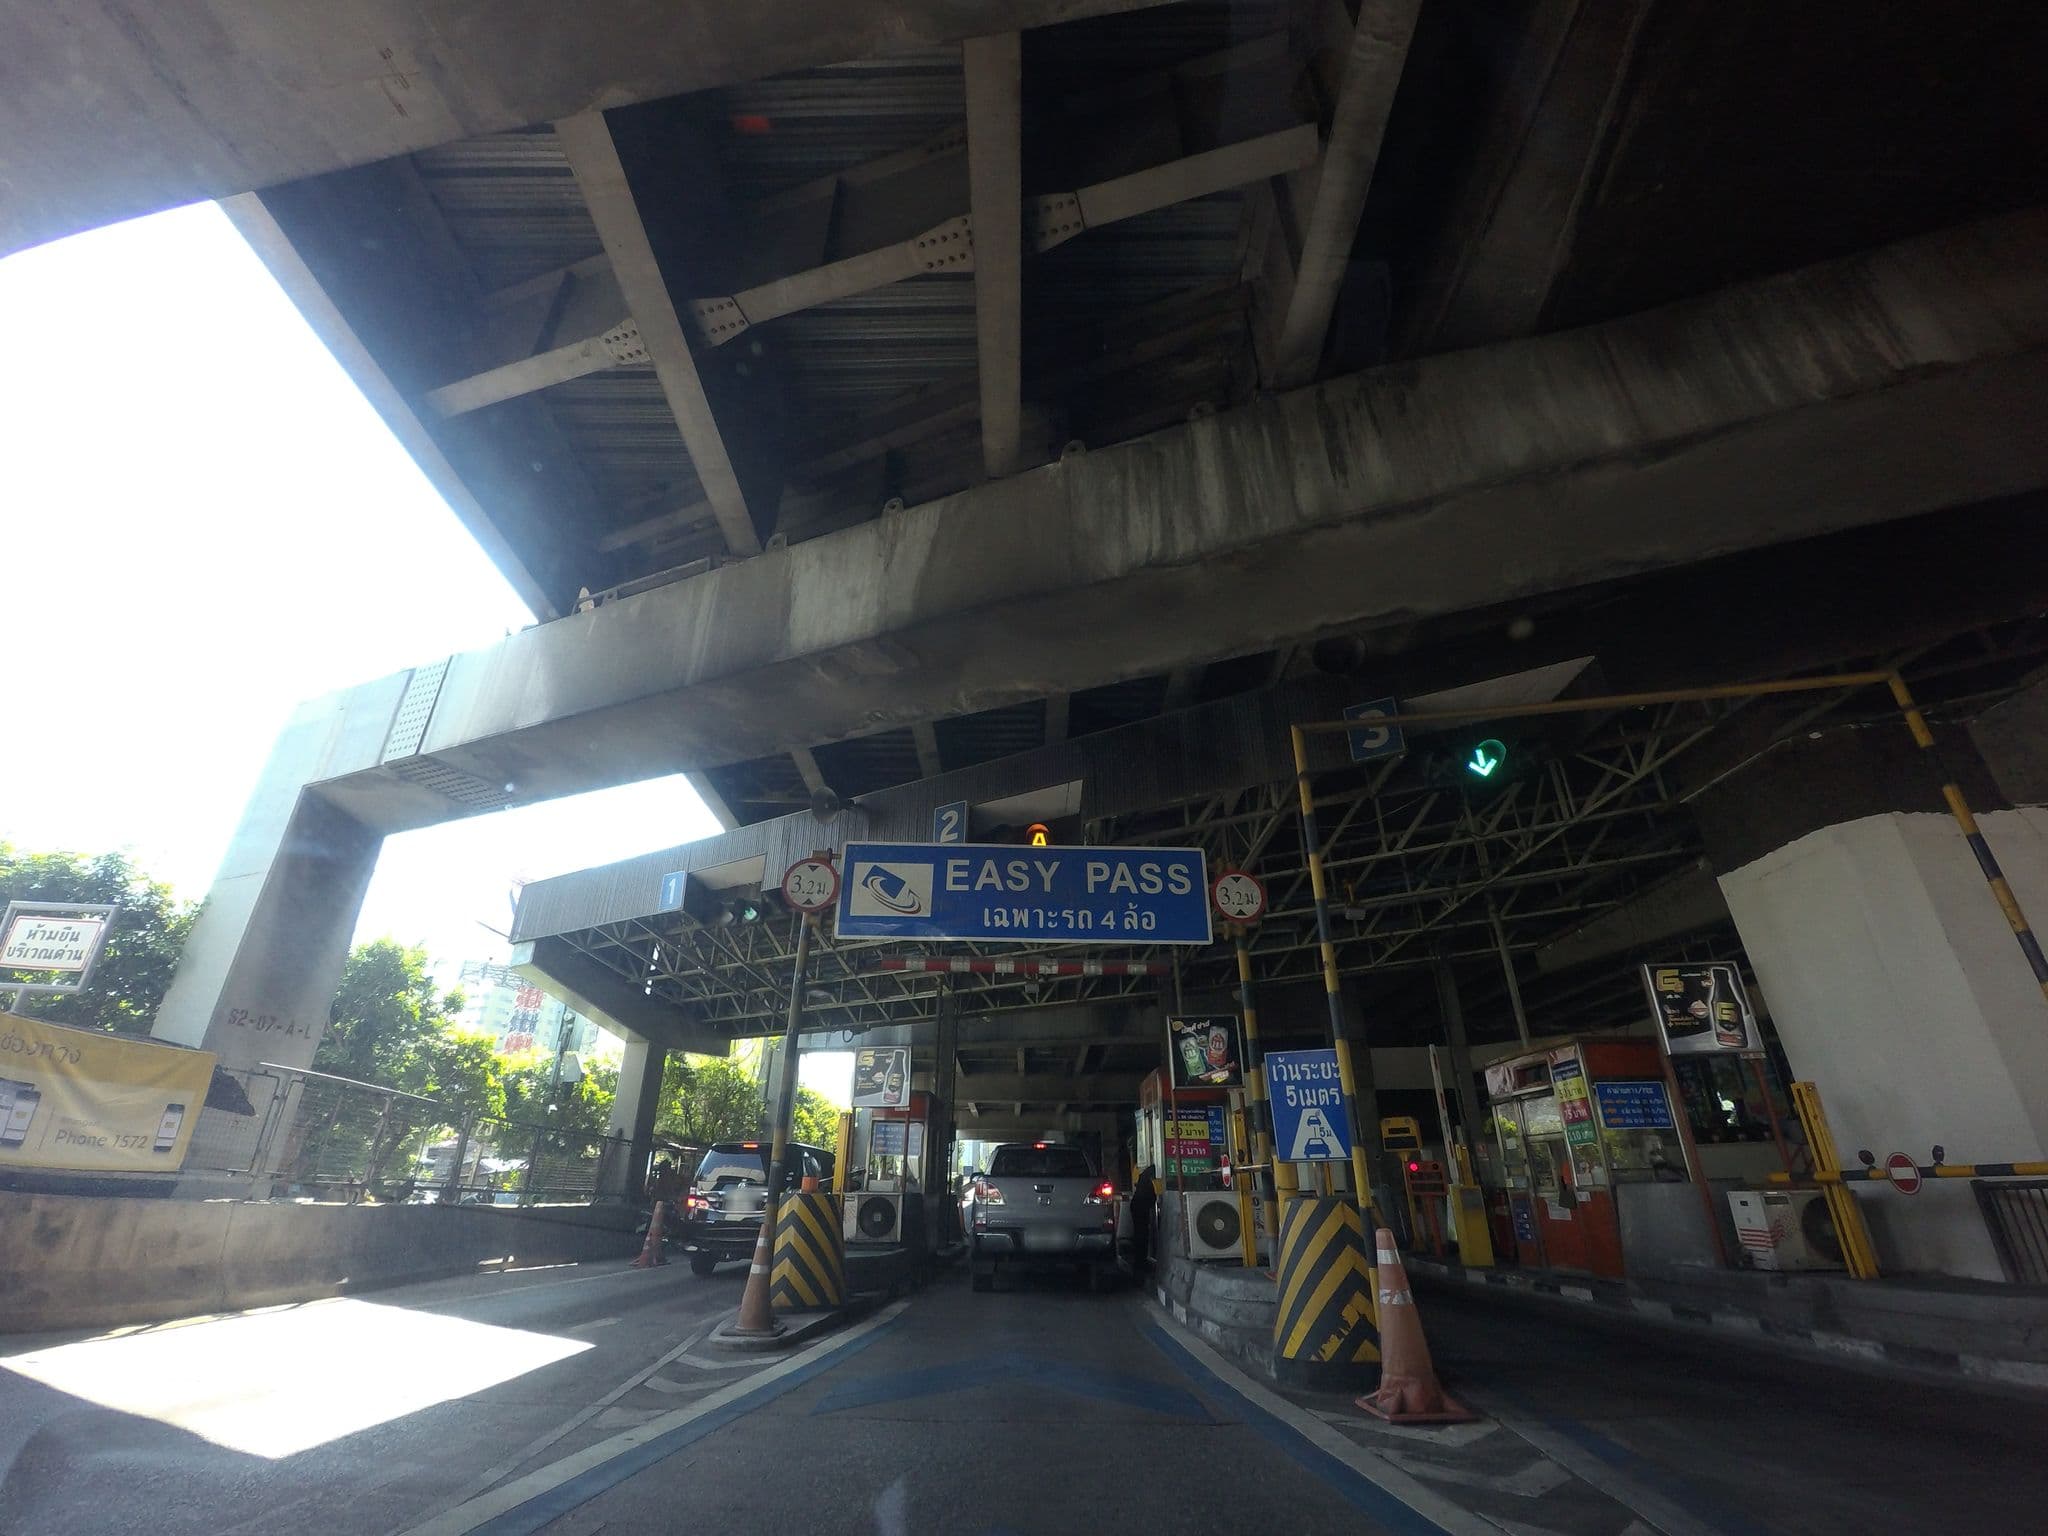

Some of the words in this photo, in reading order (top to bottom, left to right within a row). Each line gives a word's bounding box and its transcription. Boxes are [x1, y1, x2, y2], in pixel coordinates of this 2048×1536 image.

[1358, 708, 1391, 750] 3
[939, 809, 959, 844] 2
[945, 858, 1061, 893] EASY
[1086, 861, 1193, 896] PASS
[668, 877, 677, 905] 1
[983, 906, 1093, 930] เฉพาะรถ
[1100, 911, 1116, 931] 4
[1123, 901, 1156, 931] ล้อ
[26, 923, 81, 943] ห้ามยืน
[6, 942, 84, 961] บริเวณด่าน
[1272, 1056, 1341, 1082] เว้นระยะ
[54, 1128, 107, 1147] Phone
[112, 1133, 149, 1150] 1572
[1168, 1164, 1188, 1173] 10
